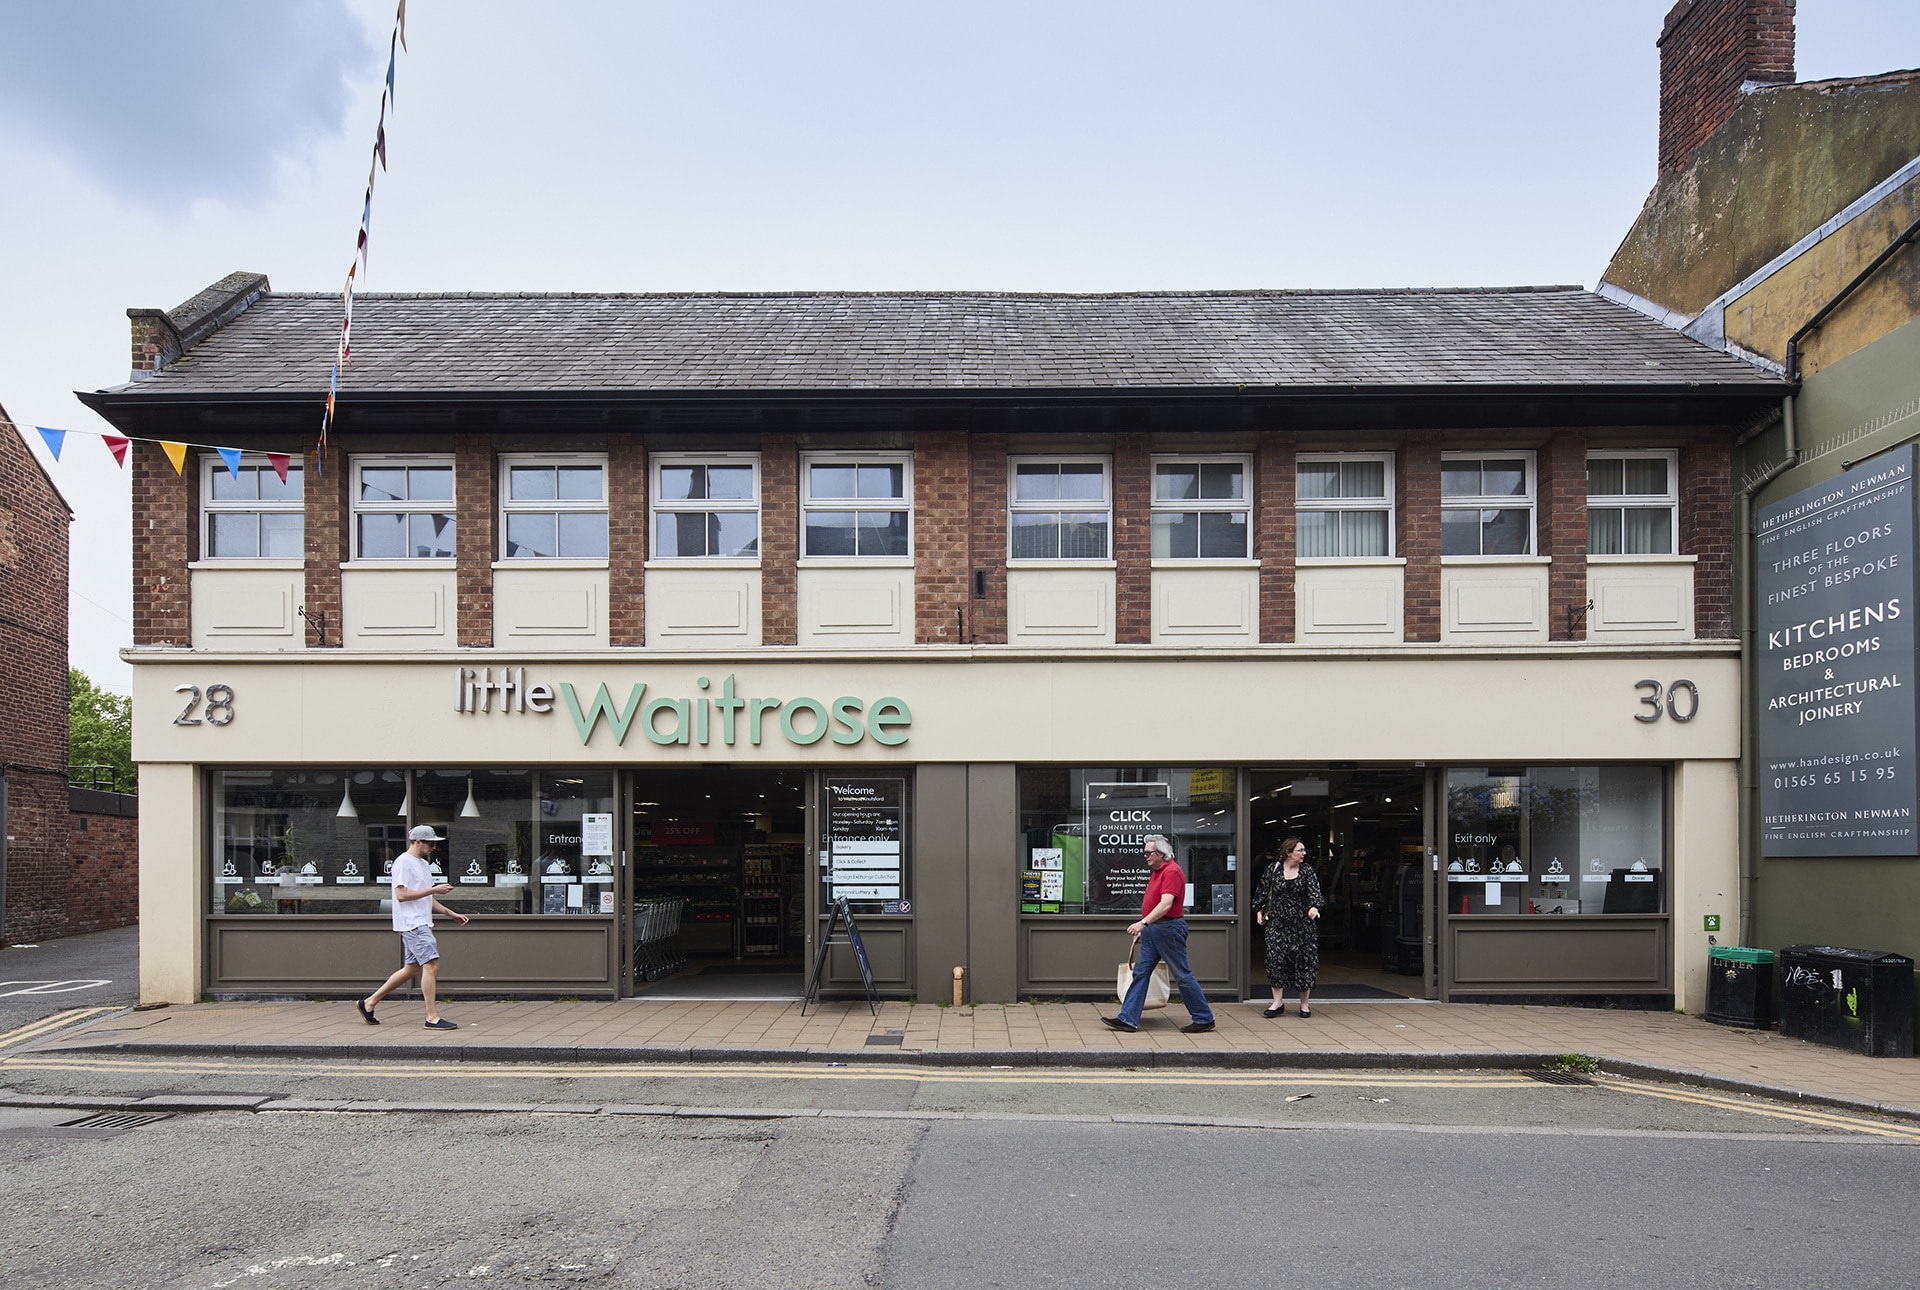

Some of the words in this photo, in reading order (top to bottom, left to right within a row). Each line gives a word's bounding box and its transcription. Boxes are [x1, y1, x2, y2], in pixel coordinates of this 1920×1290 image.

[1762, 490, 1844, 529] HETHERINGTON
[1851, 464, 1906, 494] NEWMAN
[1762, 534, 1781, 546] FINE
[1784, 518, 1822, 537] ENGLISH
[1827, 485, 1906, 521] CRAFTMANSHIP
[1772, 548, 1819, 573] THREE
[1826, 522, 1892, 556] FLOORS
[1808, 563, 1823, 575] OF
[1827, 554, 1849, 569] THE
[1768, 580, 1818, 605] FINEST
[1825, 554, 1899, 588] BESPOKE
[1768, 598, 1901, 650] KITCHENS
[1783, 636, 1881, 671] BEDROOMS
[1824, 668, 1834, 680] &
[1633, 679, 1699, 724] 30
[1768, 674, 1902, 710] ARCHITECTURAL
[172, 683, 235, 726] 28
[453, 666, 554, 713] little
[558, 673, 912, 747] Waitrose
[1798, 700, 1864, 726] JOINERY
[1770, 747, 1901, 770] www.handesign.co.uk
[1774, 774, 1816, 789] 01565
[1823, 771, 1841, 785] 65
[1851, 769, 1867, 782] 15
[1876, 766, 1896, 780] 95
[833, 784, 875, 795] Welcome
[1109, 810, 1152, 822] CLICK
[1765, 811, 1847, 824] HETHERINGTON
[1854, 807, 1910, 820] NEWMAN
[665, 827, 681, 835] 25%
[682, 827, 700, 835] OFF
[822, 834, 866, 843] Entrance
[868, 833, 890, 841] only
[1455, 833, 1473, 843] Exit
[1475, 833, 1498, 846] only
[1788, 831, 1826, 839] ENGLISH
[1830, 828, 1910, 838] CRAFTMANSHIP
[1713, 958, 1754, 970] LITTER
